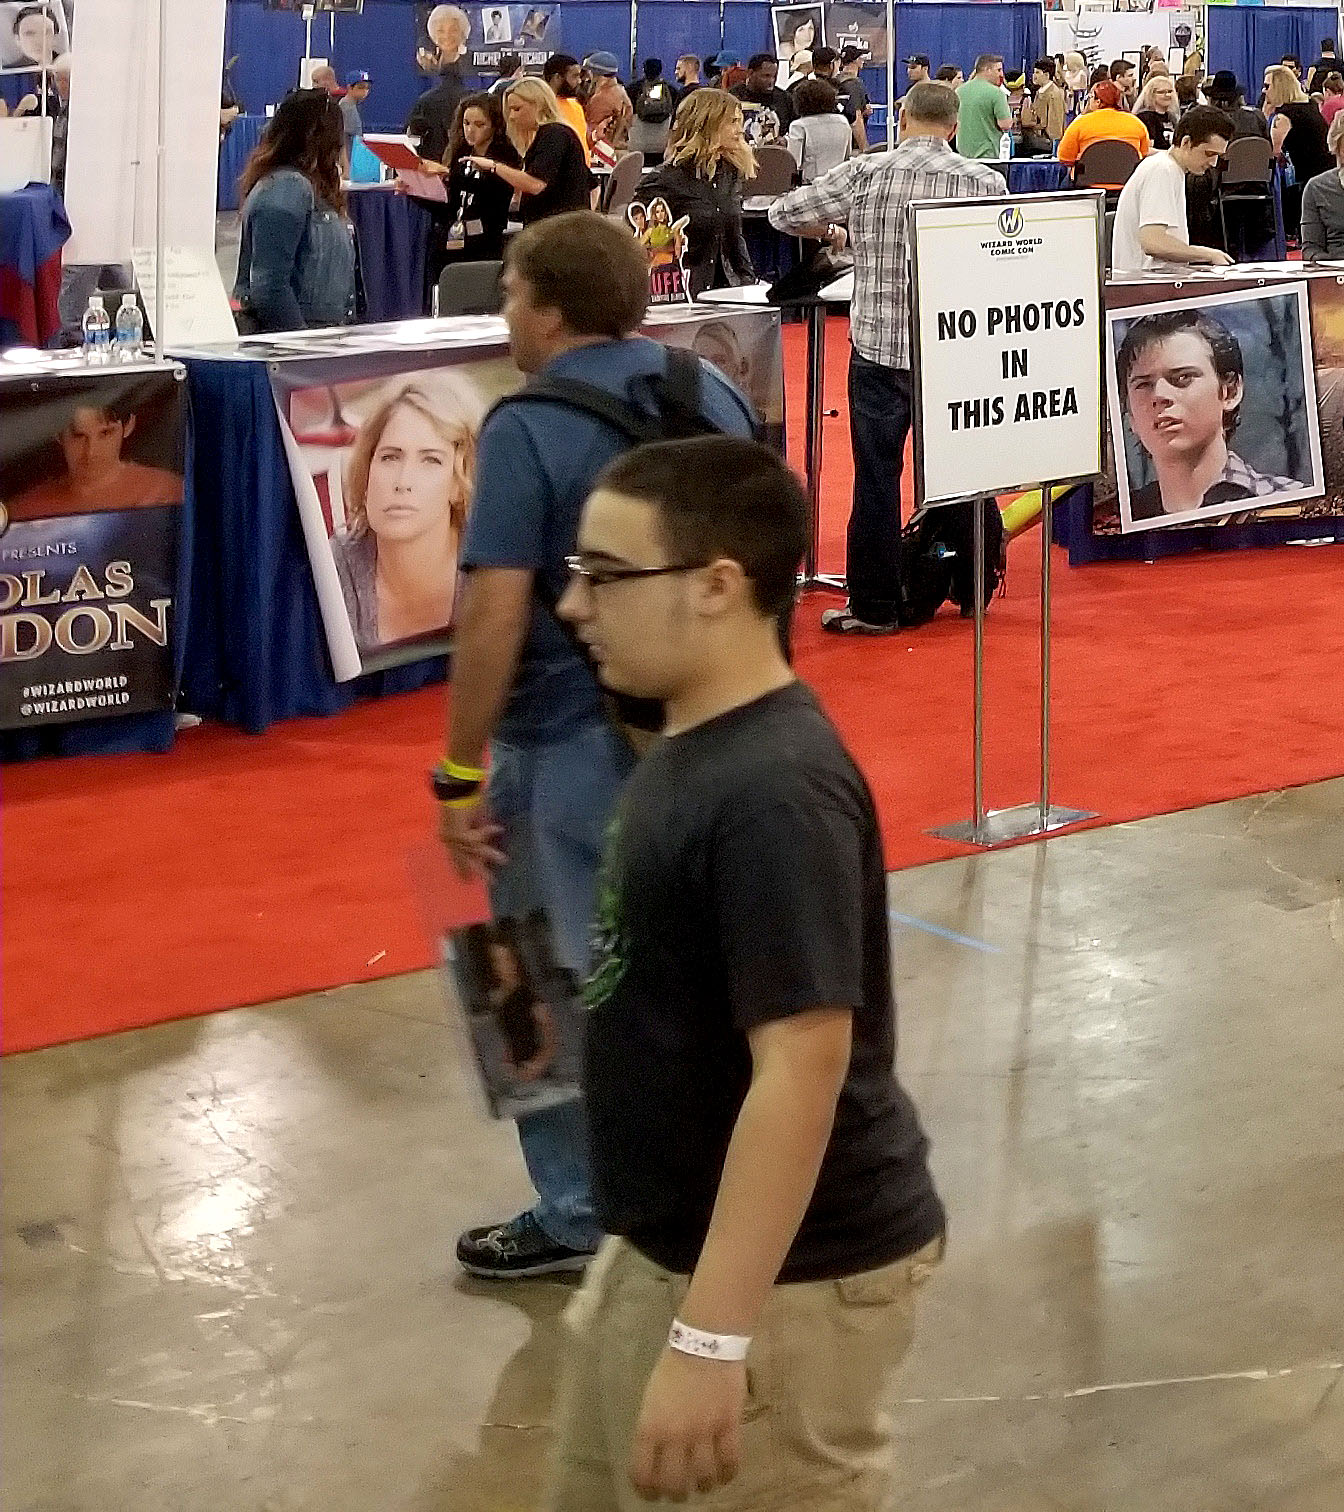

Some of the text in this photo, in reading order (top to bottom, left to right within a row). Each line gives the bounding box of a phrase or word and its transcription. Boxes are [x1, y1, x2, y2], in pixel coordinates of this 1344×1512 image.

[980, 238, 1043, 249] WIZARD WORLD
[990, 248, 1015, 256] COMIC
[937, 298, 1085, 341] NO PHOTOS
[1001, 348, 1028, 379] IN
[947, 386, 1078, 431] THIS AREA
[19, 691, 131, 716] @WIZARDWORLD
